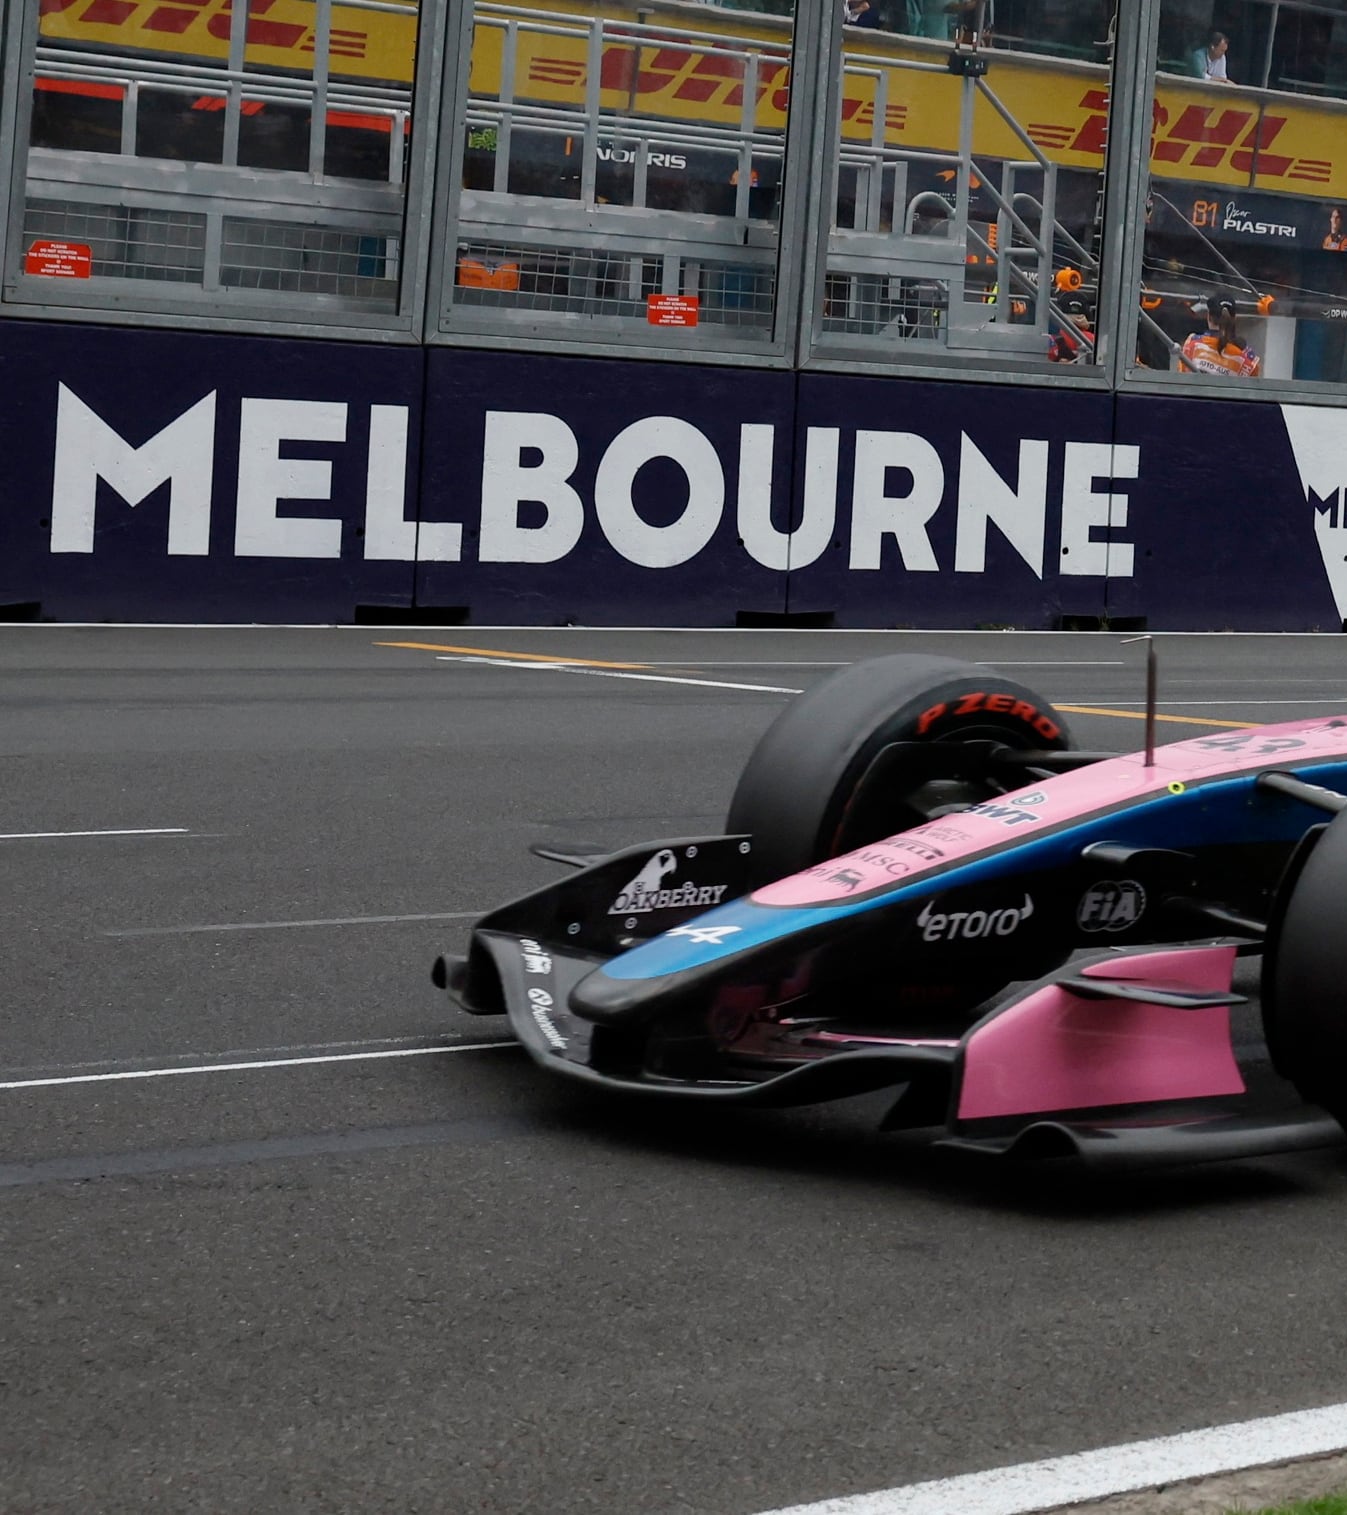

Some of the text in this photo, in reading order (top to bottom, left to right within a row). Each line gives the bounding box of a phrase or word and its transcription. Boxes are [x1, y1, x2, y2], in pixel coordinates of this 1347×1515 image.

[1193, 200, 1219, 227] 81
[1223, 219, 1297, 237] PIASTRI
[50, 381, 1140, 580] MELBOURNE
[953, 692, 1061, 740] ZERO
[606, 885, 728, 914] OAKBERRY
[1082, 892, 1139, 921] FIA
